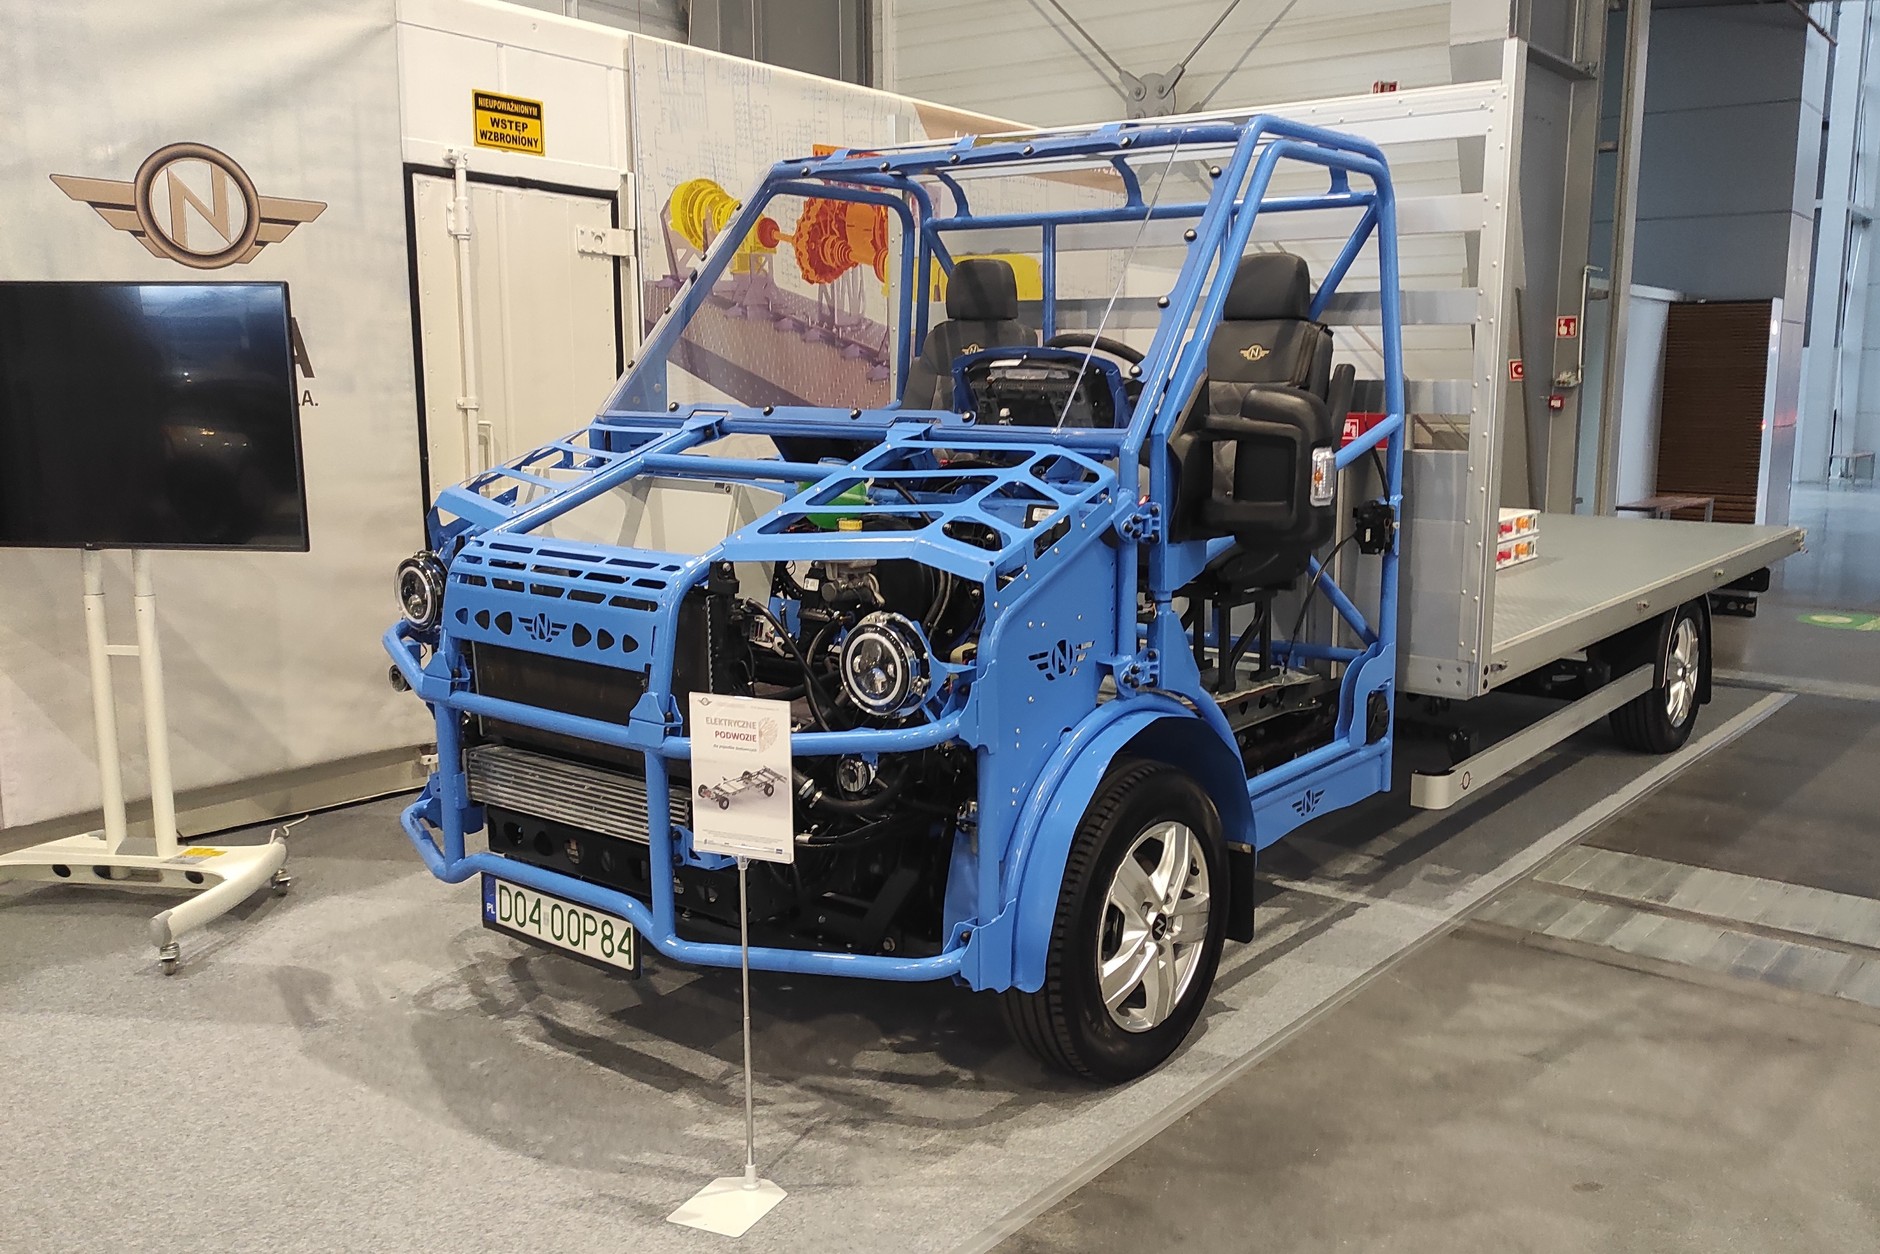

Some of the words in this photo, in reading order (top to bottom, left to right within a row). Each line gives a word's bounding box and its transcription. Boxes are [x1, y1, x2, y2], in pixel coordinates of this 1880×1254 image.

[478, 96, 538, 117] NIEUPOWAŻNIONYM
[490, 116, 528, 135] WSTĘP
[480, 129, 539, 148] WZBRONIONY
[705, 716, 757, 730] ELEKTRYCZNE
[714, 730, 757, 743] PODWOZIE
[486, 902, 496, 915] PL
